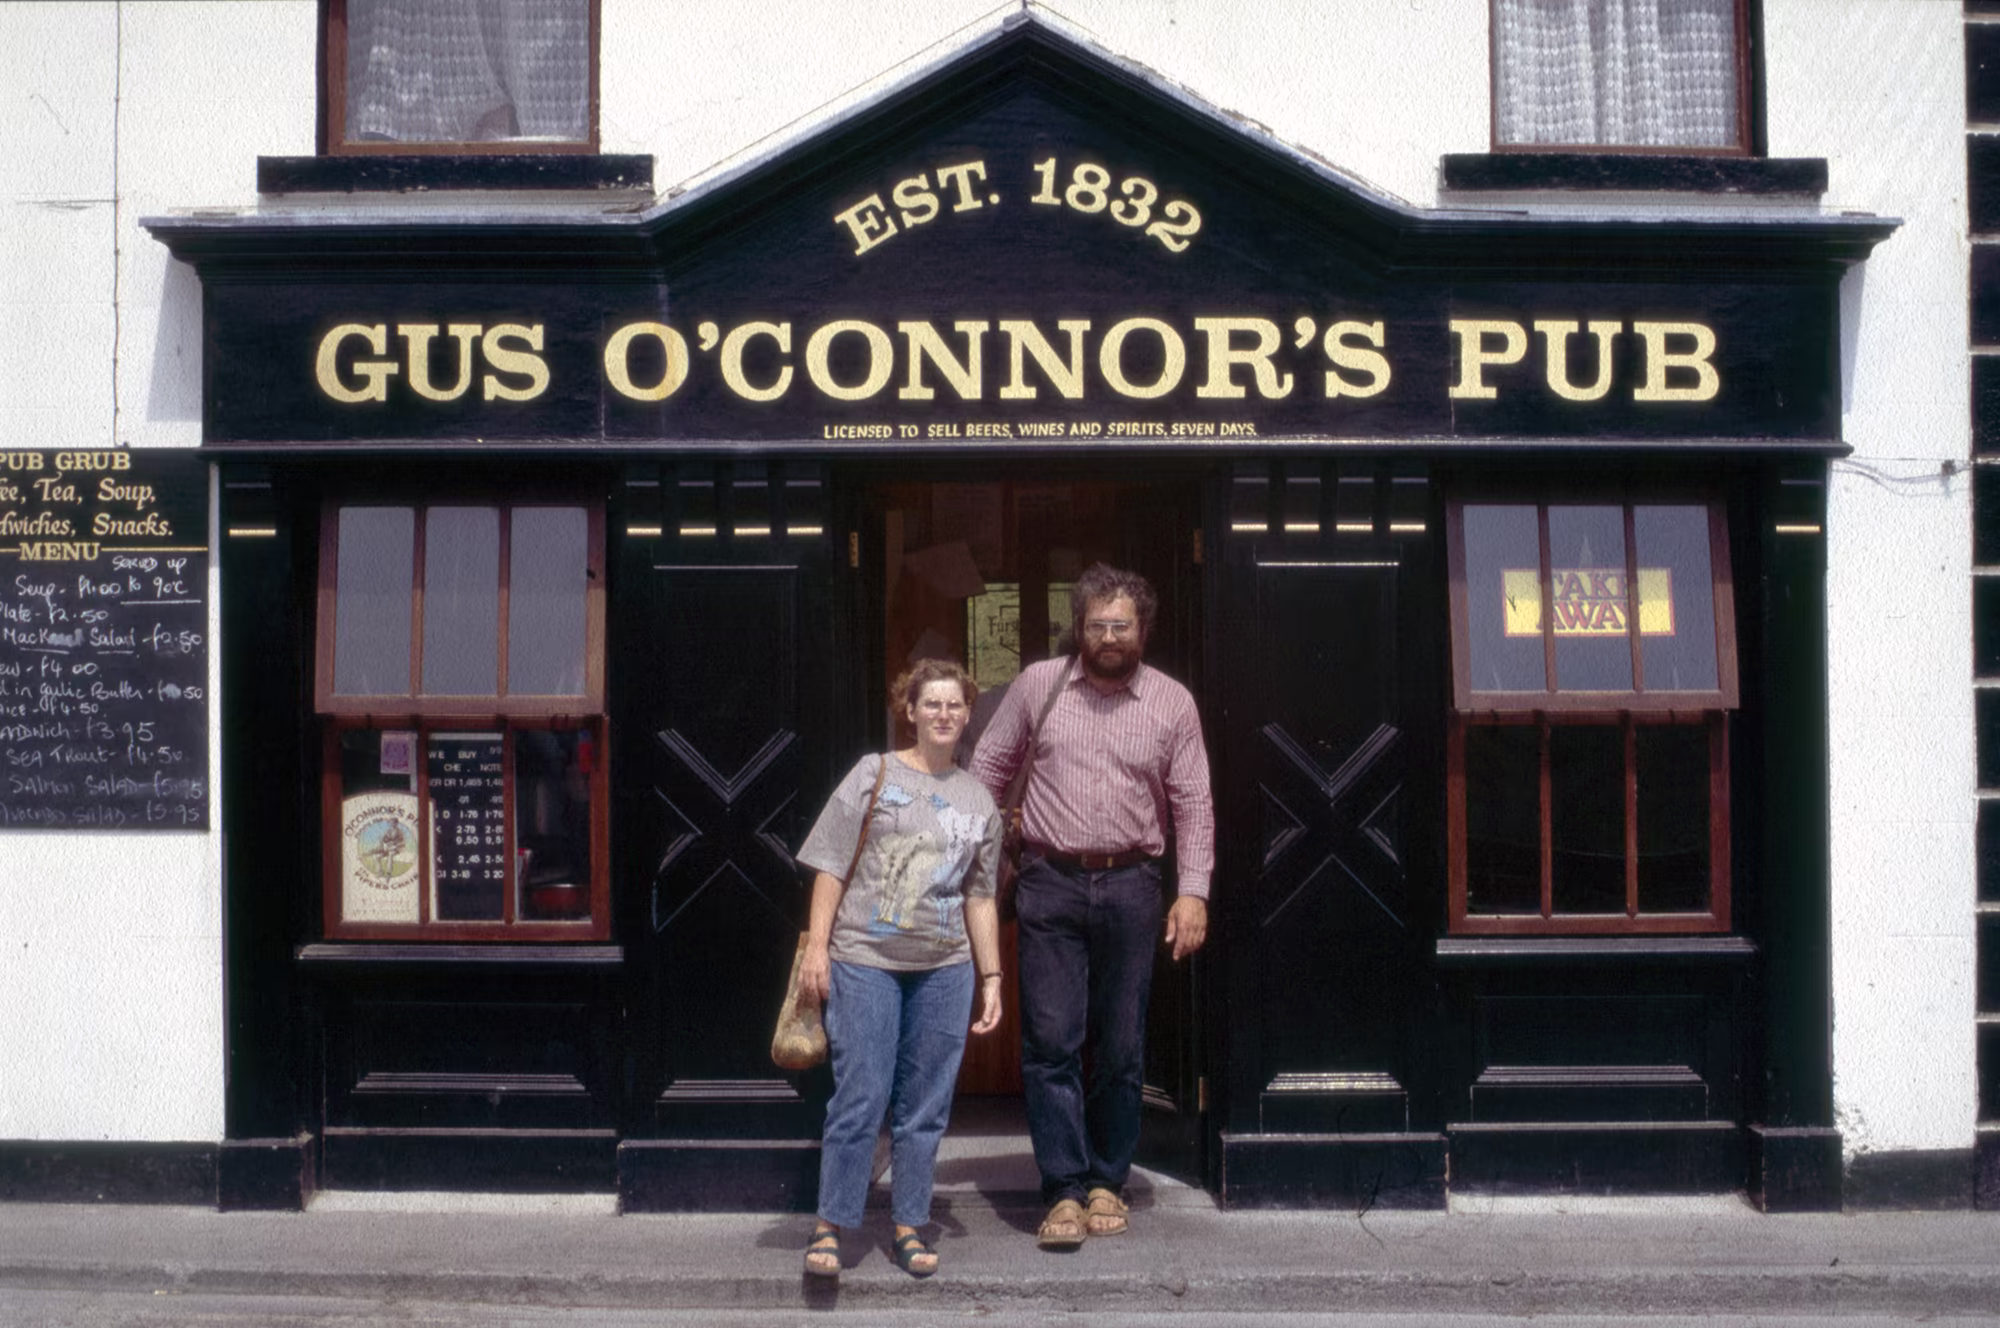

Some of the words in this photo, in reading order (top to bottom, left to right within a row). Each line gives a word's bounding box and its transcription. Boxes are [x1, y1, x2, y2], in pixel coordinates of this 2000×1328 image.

[834, 160, 1000, 256] EST.
[1031, 157, 1202, 253] 1832
[315, 323, 551, 404] GUS
[603, 316, 1392, 402] O'CONNOR'S
[1448, 318, 1721, 401] PUB
[823, 425, 893, 439] LICENSED
[899, 424, 919, 438] TO
[927, 424, 961, 438] SELL
[965, 423, 1013, 439] BEERS,
[1018, 423, 1065, 437] WINES
[1070, 423, 1102, 437] AND
[1107, 423, 1167, 437] SPIRITS,
[1171, 423, 1214, 436] SEVEN
[1220, 422, 1257, 437] DAYS.
[55, 452, 131, 470] GRUB
[33, 472, 83, 505] Tea,
[97, 477, 156, 510] Soup,
[93, 511, 174, 537] Snacks.
[19, 542, 100, 561] MENU
[166, 556, 188, 575] up
[6, 748, 43, 768] SEA
[458, 750, 477, 760] BUY
